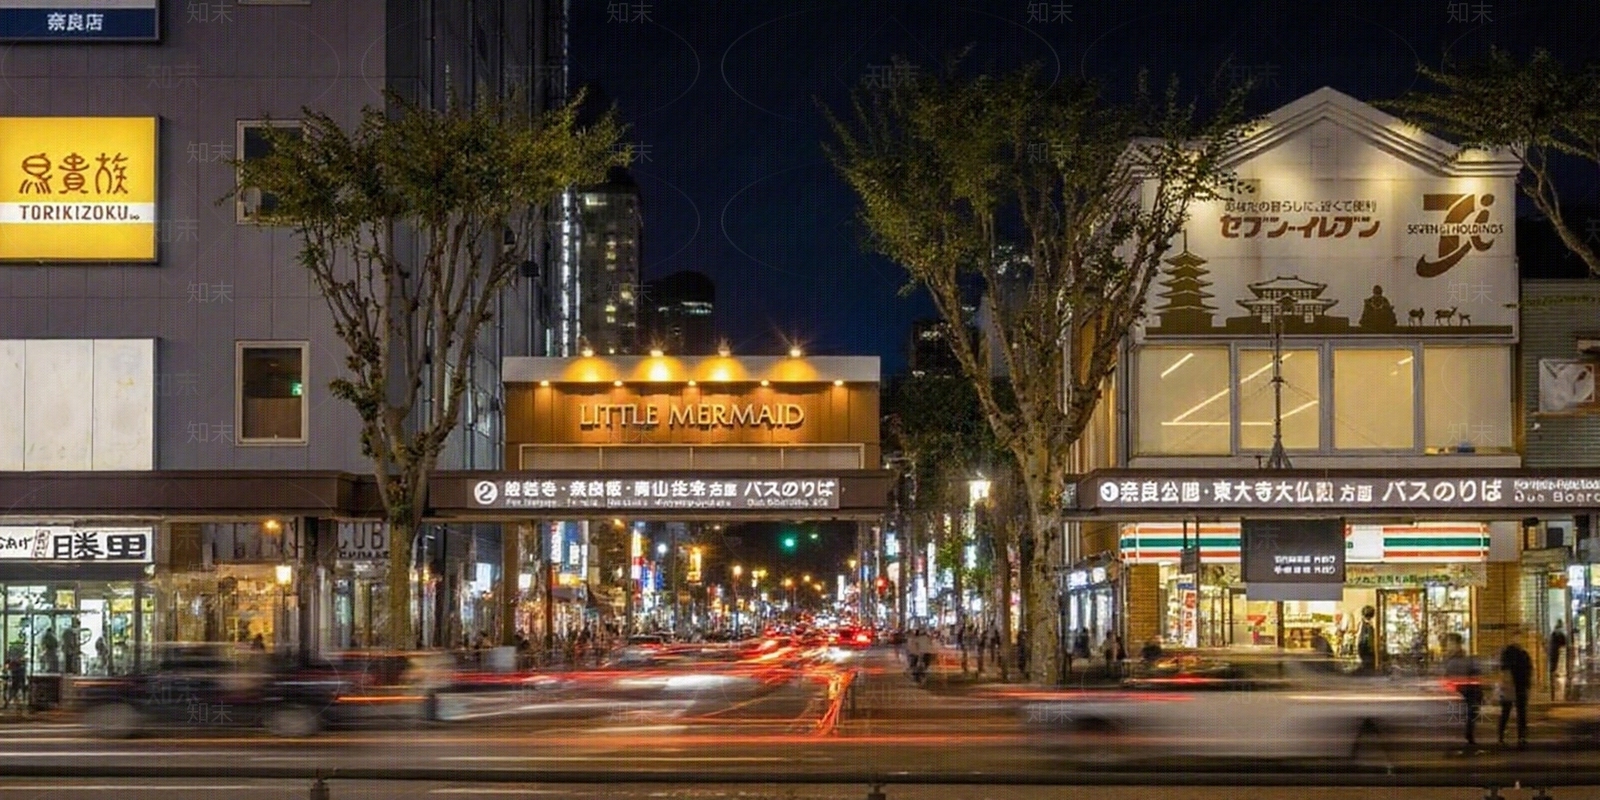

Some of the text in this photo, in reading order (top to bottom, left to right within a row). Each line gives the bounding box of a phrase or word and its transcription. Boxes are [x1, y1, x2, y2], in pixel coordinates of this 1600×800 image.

[47, 12, 104, 31] 奈良店
[19, 153, 128, 194] 鳥貴族
[19, 205, 128, 220] TORIKIZOKU
[580, 404, 805, 428] LITTLE MERMAID
[744, 480, 835, 497] バスのりば
[1382, 480, 1502, 502] バスのりば
